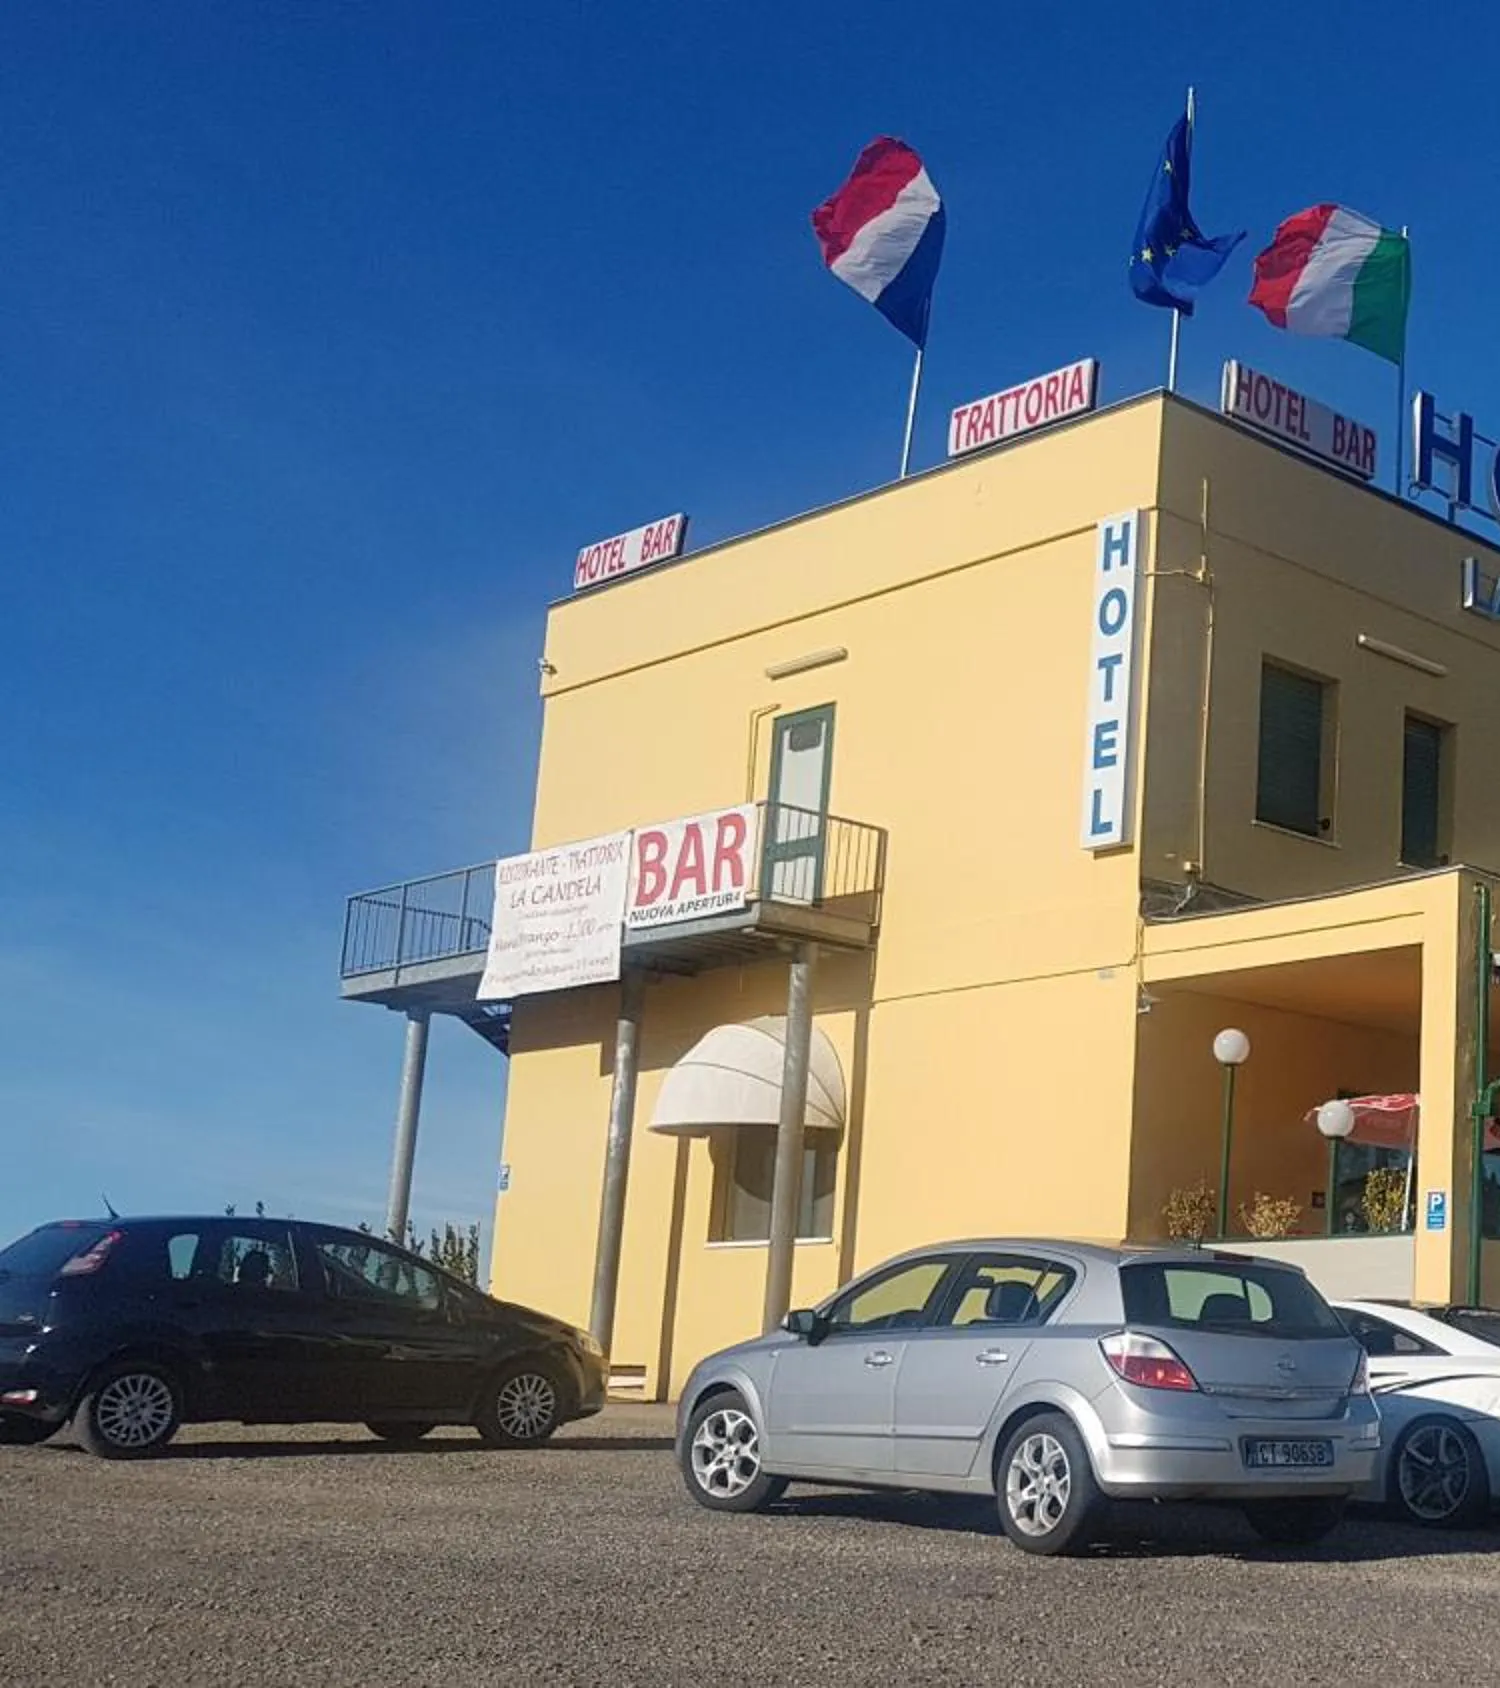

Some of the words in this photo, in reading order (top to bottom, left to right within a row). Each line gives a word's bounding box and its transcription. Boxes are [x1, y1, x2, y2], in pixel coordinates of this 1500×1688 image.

[952, 365, 1085, 451] TRATTORIA
[1235, 364, 1311, 442] HOTEL
[1332, 413, 1376, 474] BAR
[575, 540, 627, 585] HOTEL
[639, 518, 678, 562] BAR
[1090, 520, 1132, 837] HOTEL
[510, 888, 526, 909] LA
[530, 874, 601, 904] CANDELA
[634, 812, 747, 908] BAR
[631, 903, 674, 922] NUOVA
[676, 889, 741, 915] APERTURA
[1431, 1193, 1443, 1213] P
